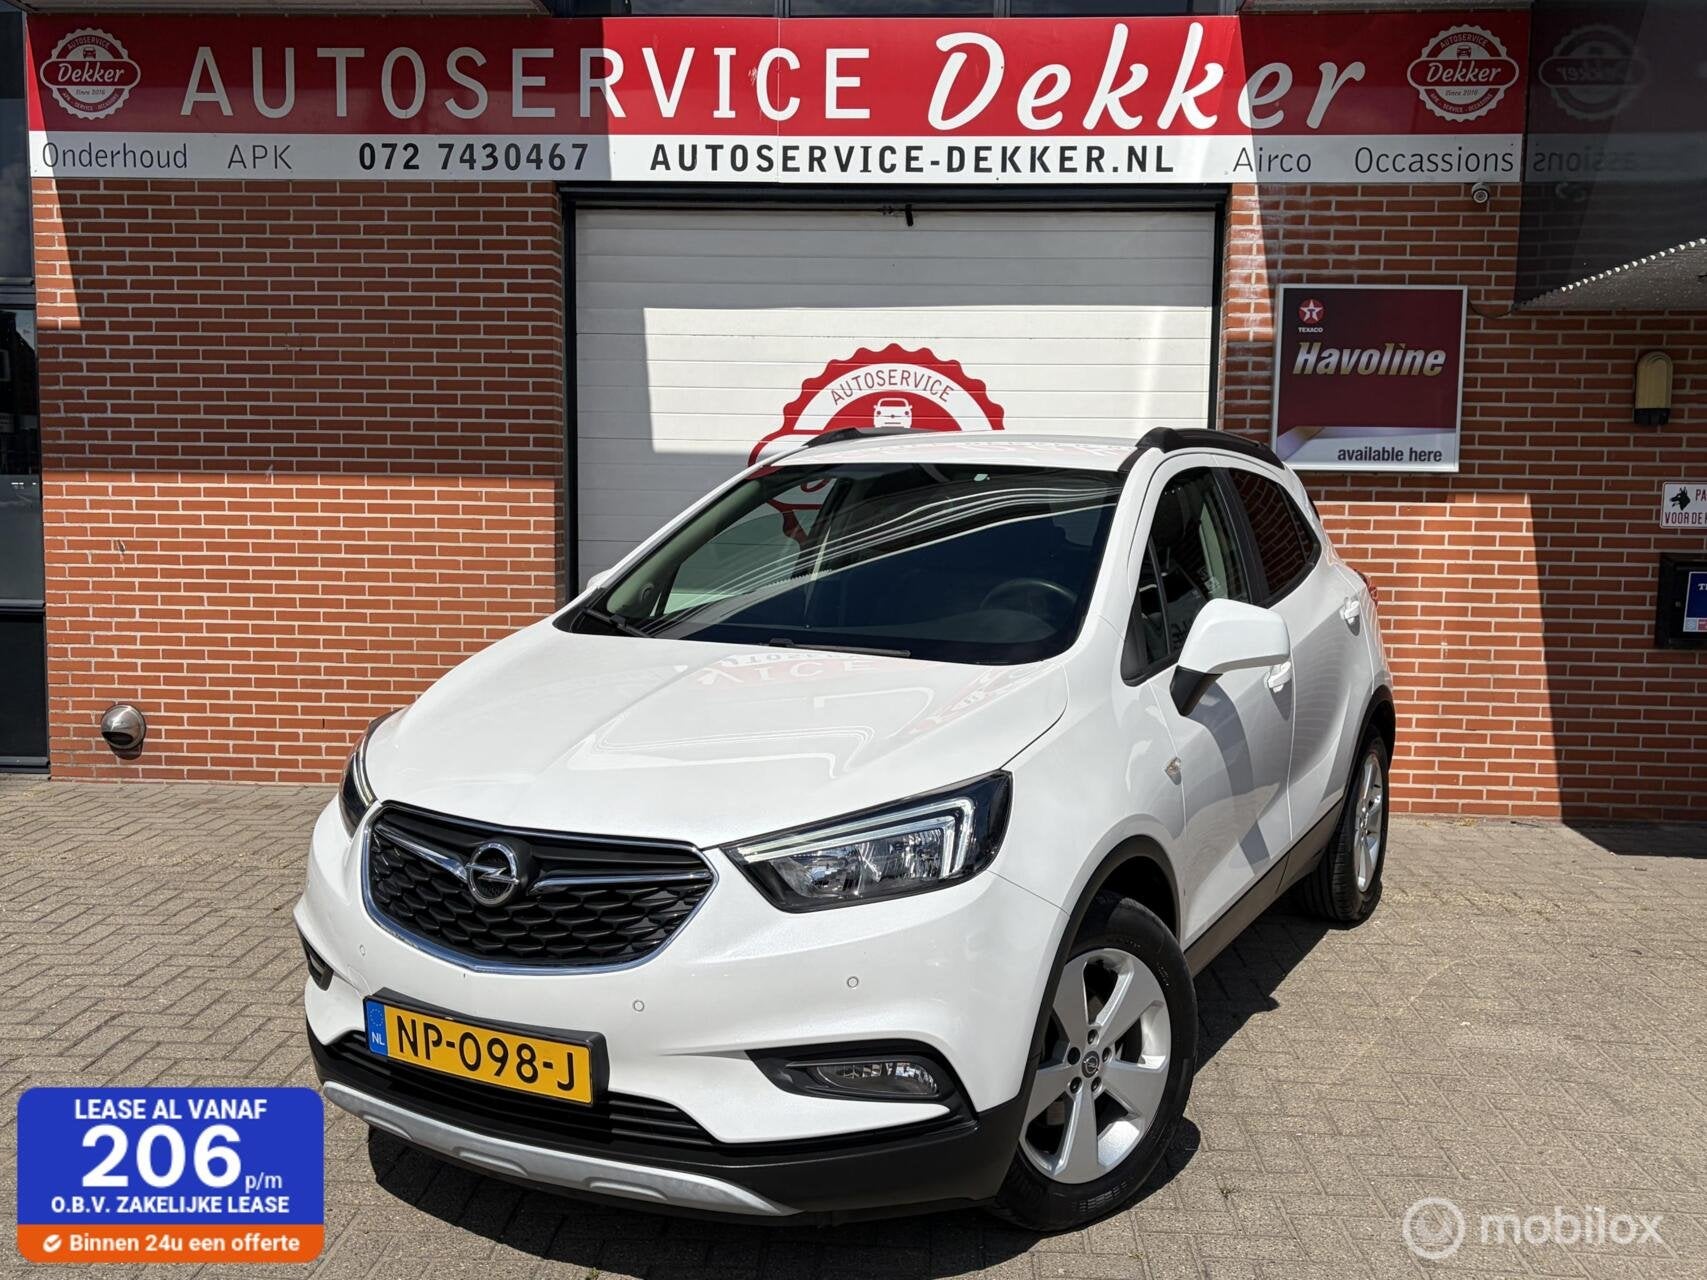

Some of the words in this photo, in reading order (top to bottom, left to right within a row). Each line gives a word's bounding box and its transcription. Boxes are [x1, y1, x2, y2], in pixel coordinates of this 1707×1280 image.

[67, 36, 110, 50] AUTOSERVICE
[1440, 33, 1489, 48] AUTOSERVICE
[58, 61, 125, 82] Dekker
[180, 46, 871, 121] AUTOSERVICE
[927, 22, 1366, 131] Dekker
[1426, 60, 1502, 83] Dekker
[42, 141, 189, 170] Onderhoud
[227, 143, 293, 170] APK
[358, 142, 420, 171] 072
[438, 142, 589, 172] 7430467
[650, 143, 1174, 174] AUTOSERVICE-DEKKER.NL
[1233, 147, 1312, 174] Airco
[1354, 145, 1514, 174] Occassions
[1292, 341, 1447, 377] Havoline
[831, 369, 955, 405] AUTOSERVICE
[1337, 446, 1404, 462] available
[1408, 447, 1443, 462] here
[1664, 511, 1690, 525] VOOR
[1691, 512, 1703, 525] DE
[372, 1031, 385, 1046] NL
[396, 1014, 575, 1092] NP-098-J
